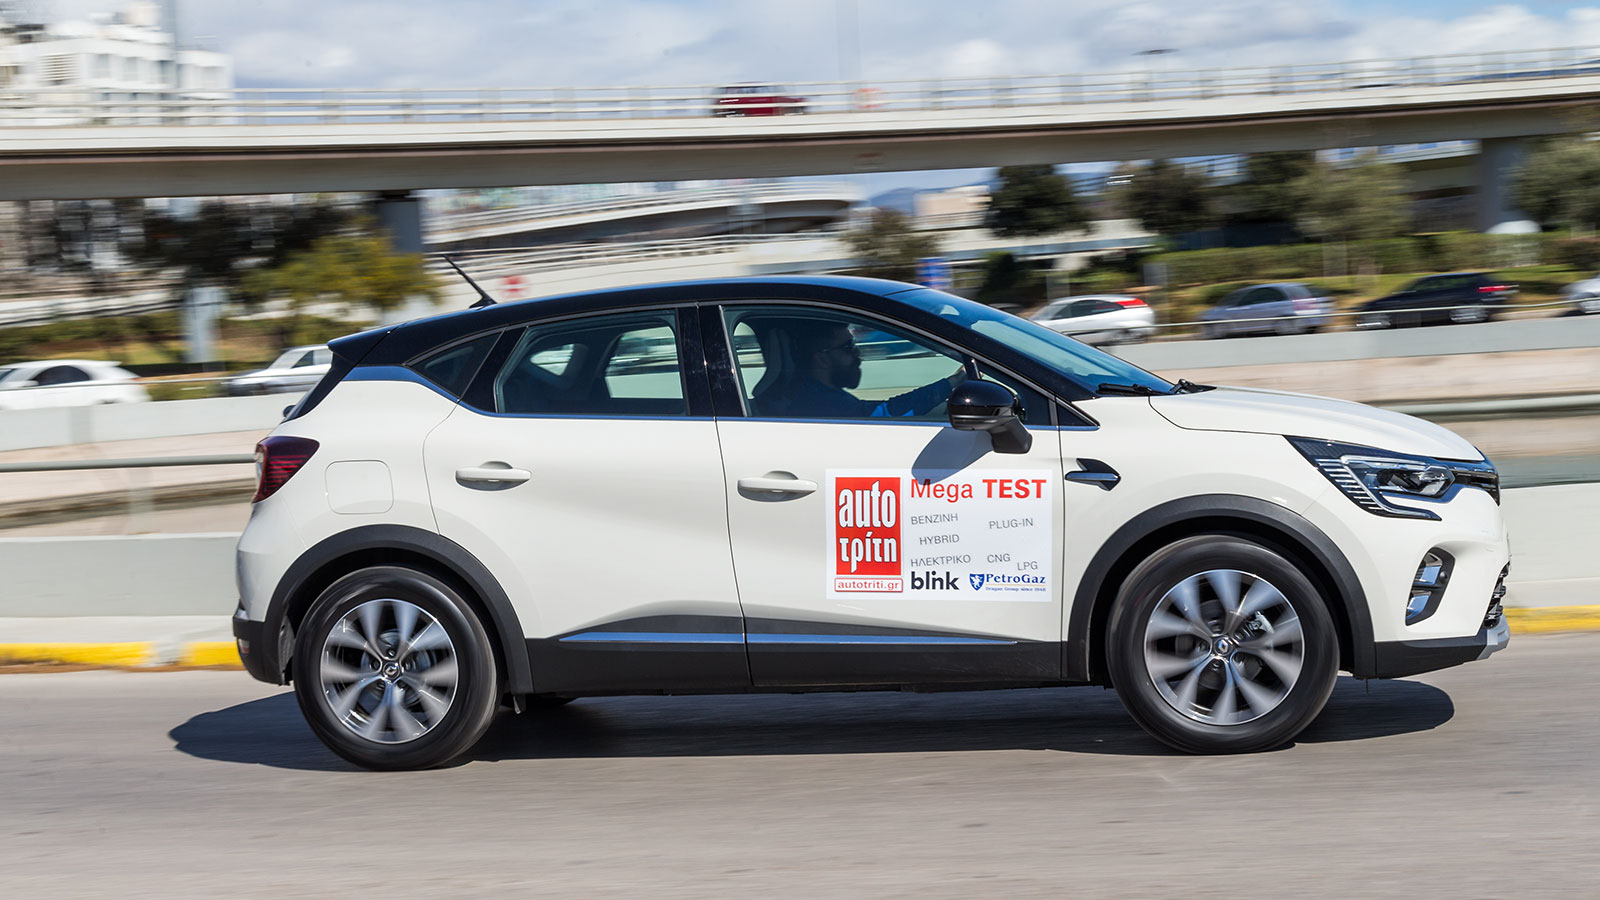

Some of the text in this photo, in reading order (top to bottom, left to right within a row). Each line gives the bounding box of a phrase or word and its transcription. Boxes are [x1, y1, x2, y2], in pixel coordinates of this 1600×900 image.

[910, 478, 1047, 503] Mega TEST
[838, 480, 897, 528] auto
[989, 518, 1034, 530] PLUG-IN
[919, 534, 960, 546] HYBRID
[839, 531, 898, 574] τρίτη
[986, 553, 1011, 564] CNG
[1016, 561, 1039, 571] LPG
[910, 571, 960, 591] blink
[986, 573, 1046, 585] PetroGaz
[837, 581, 900, 591] autotriti.gr
